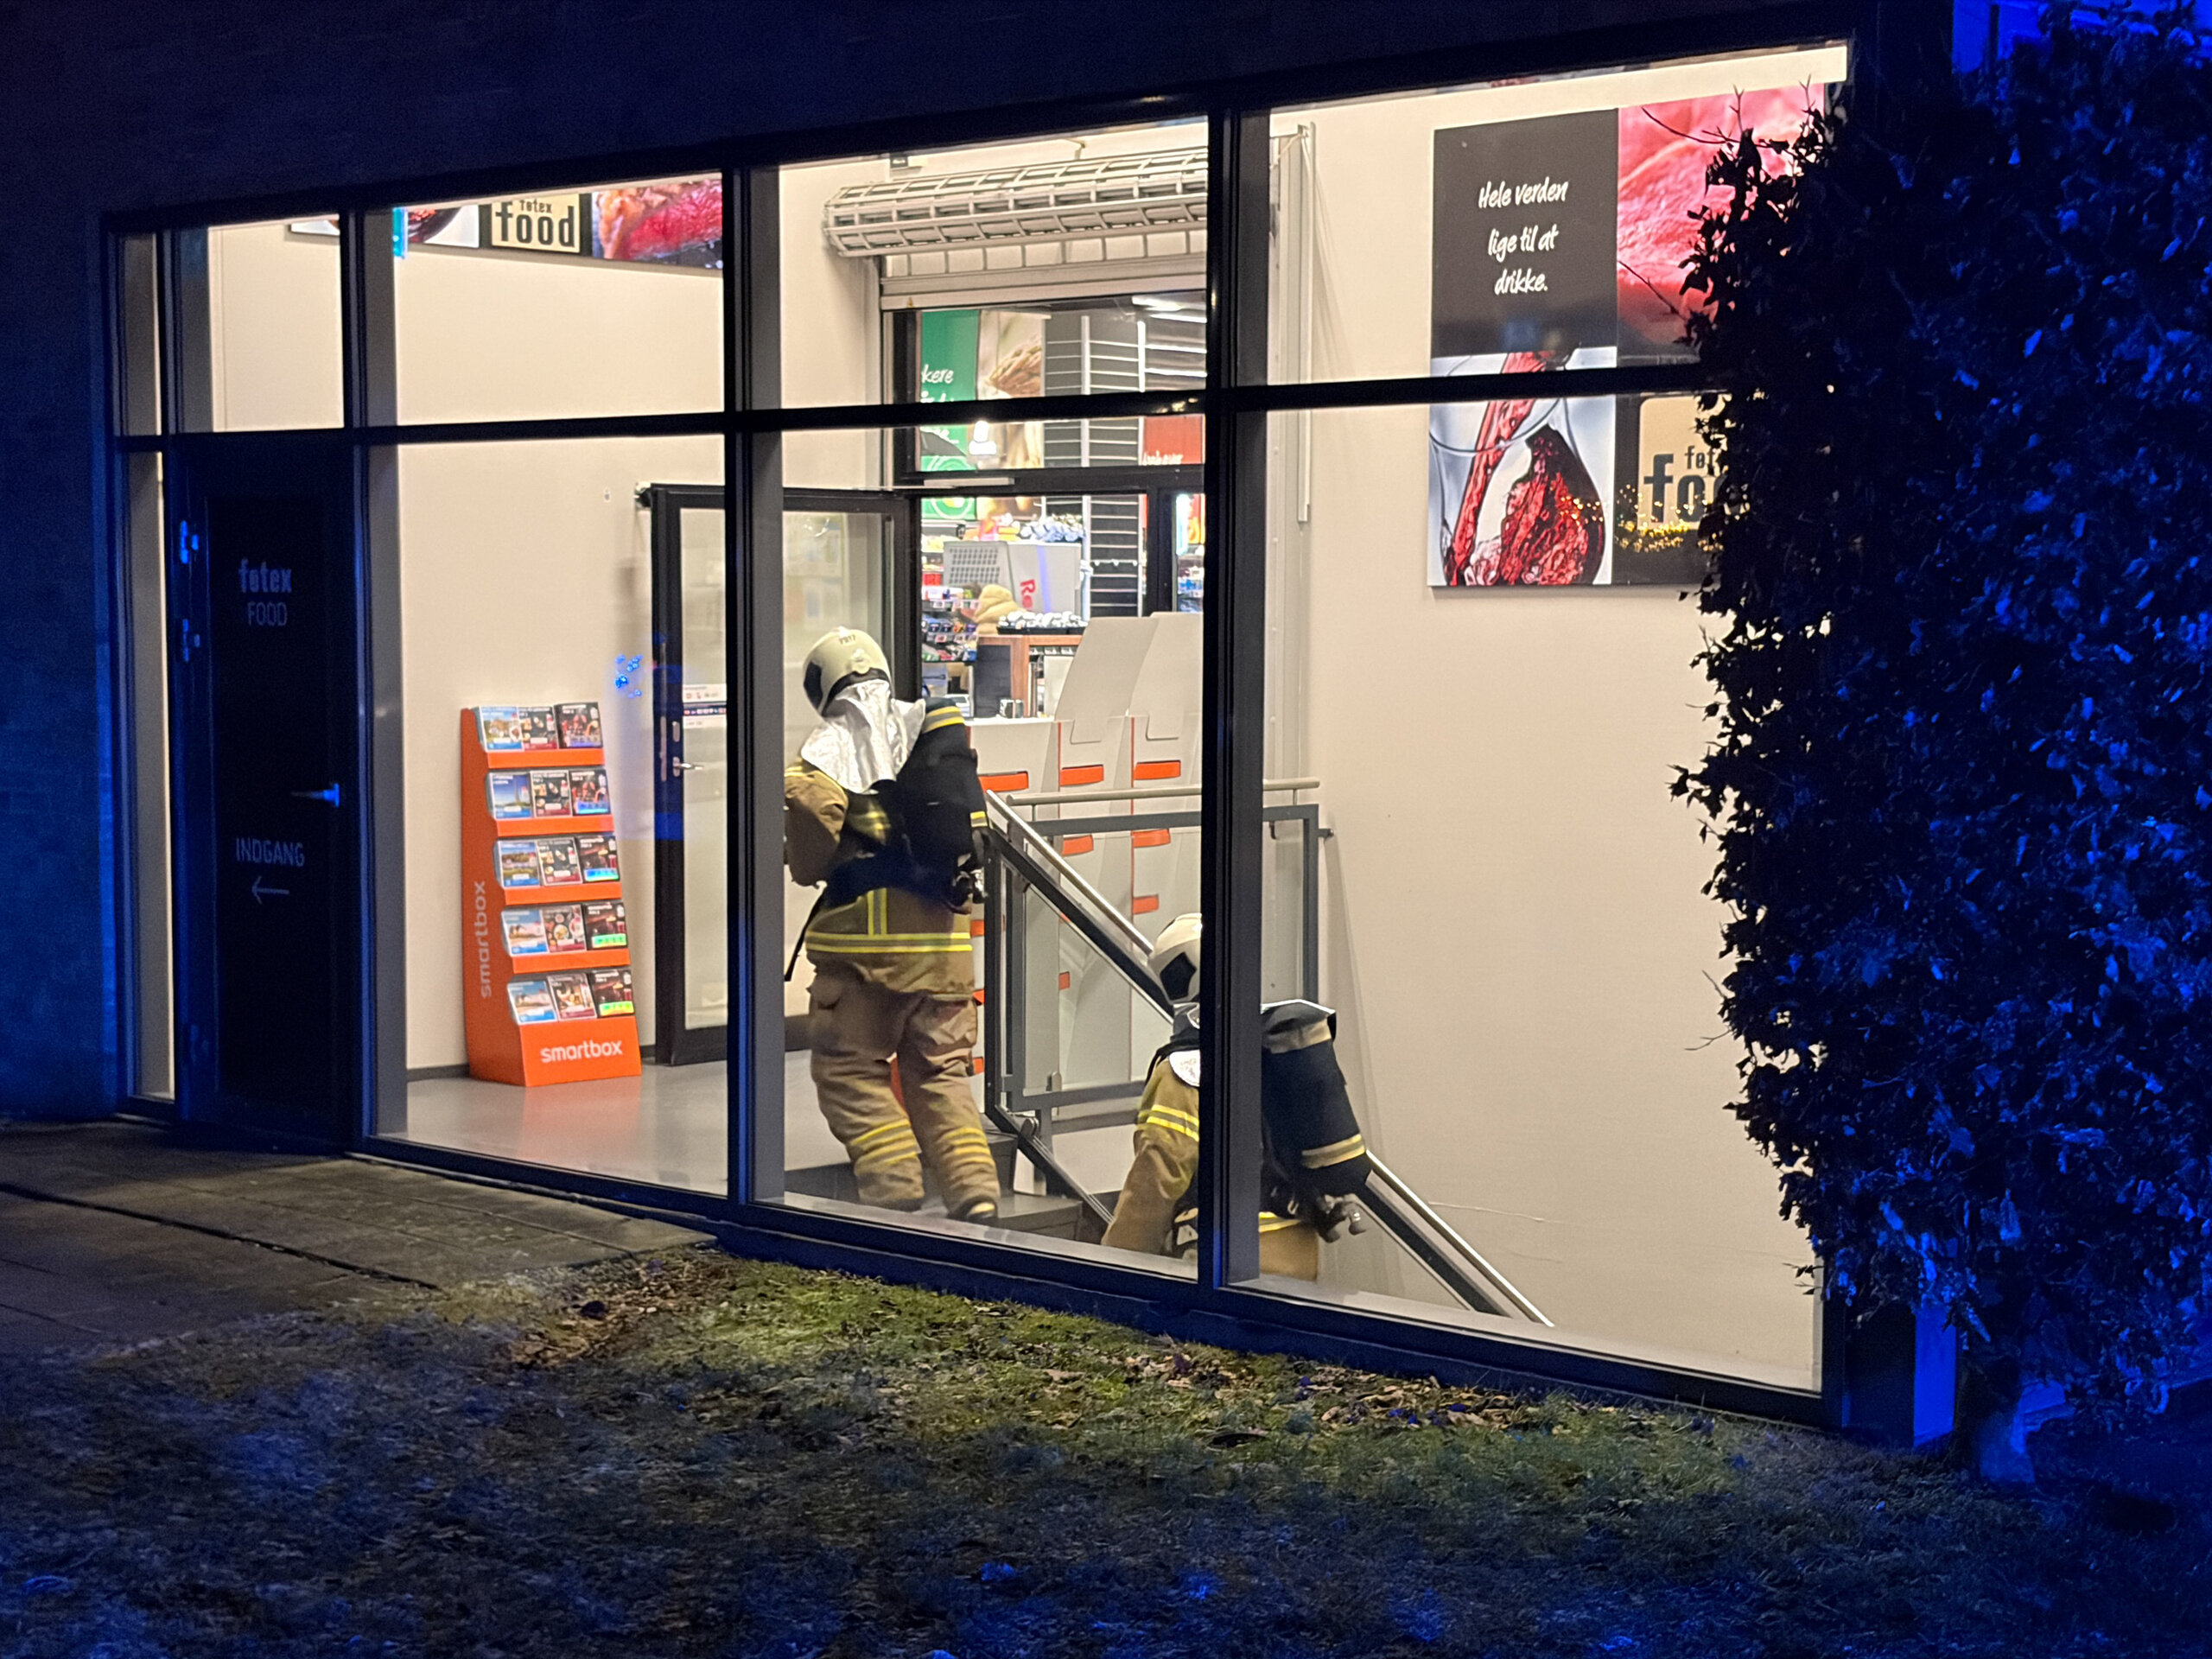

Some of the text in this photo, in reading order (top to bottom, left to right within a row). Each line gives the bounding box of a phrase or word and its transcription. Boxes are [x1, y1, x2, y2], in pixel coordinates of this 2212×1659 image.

[1478, 175, 1569, 208] Hele verden
[495, 201, 575, 247] food
[1487, 223, 1560, 263] lige til at
[1493, 267, 1548, 296] drikke.
[1684, 445, 1717, 474] føt
[247, 601, 289, 626] FOOD
[236, 837, 306, 868] INDGANG
[474, 880, 492, 998] smartbox
[540, 1039, 623, 1064] smartbox
